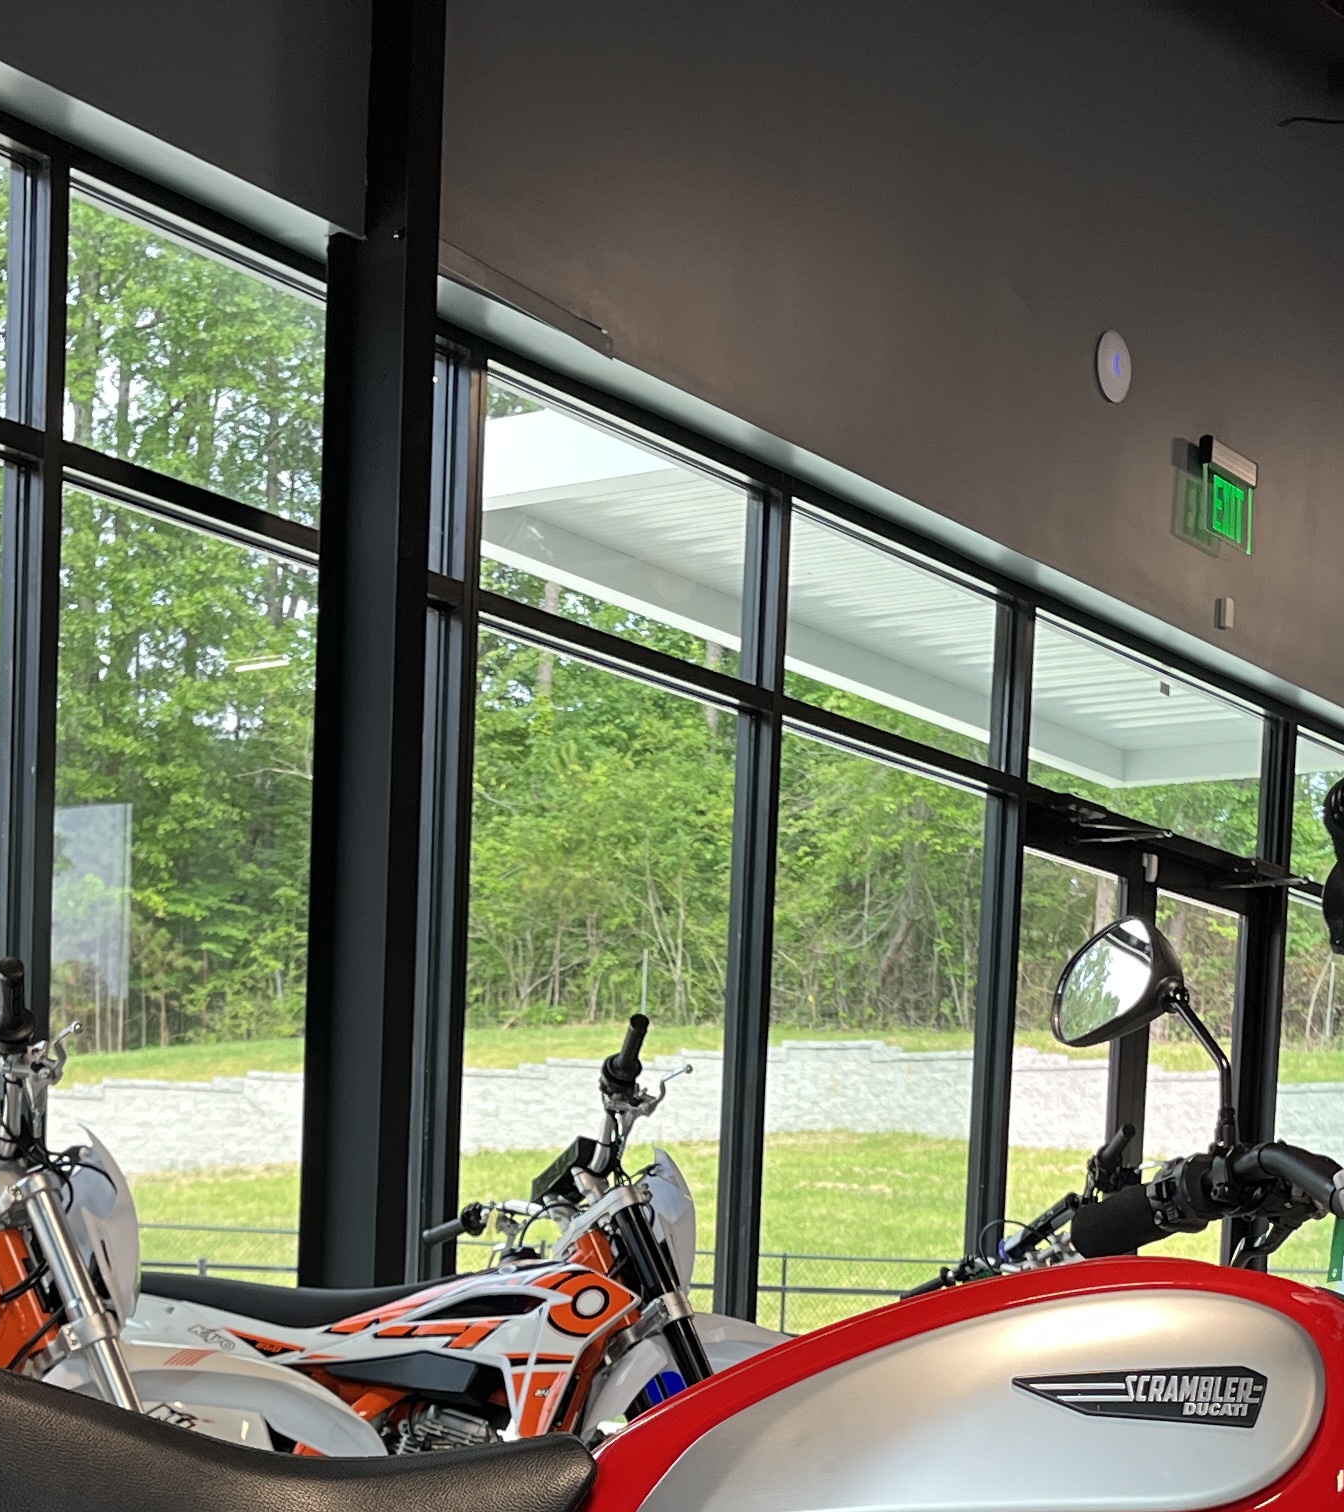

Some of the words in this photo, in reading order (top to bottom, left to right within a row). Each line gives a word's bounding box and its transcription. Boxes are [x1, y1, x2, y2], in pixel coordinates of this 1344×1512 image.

[1213, 474, 1245, 544] EXIT
[1124, 1375, 1258, 1402] SCRAMBLER
[1182, 1402, 1249, 1417] DUCATI
